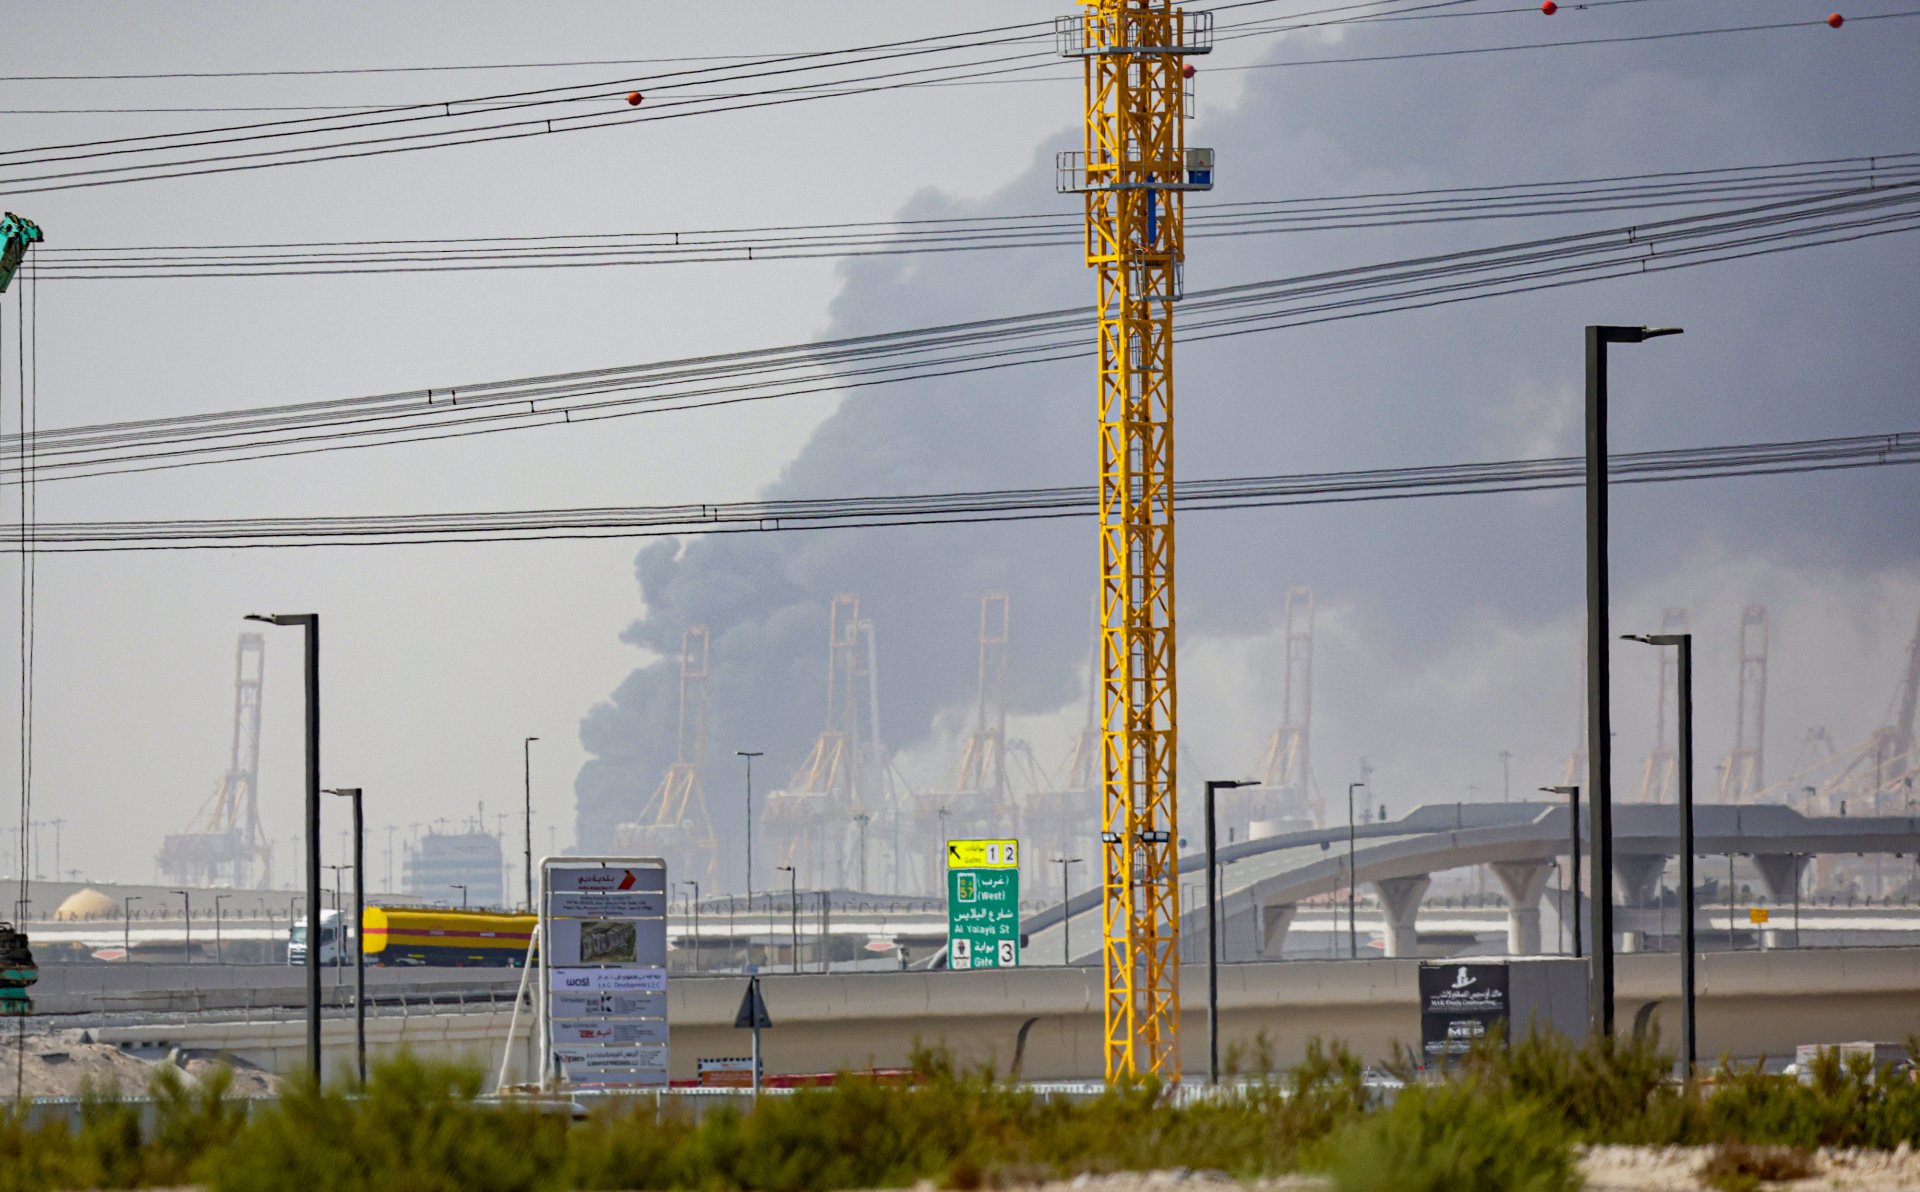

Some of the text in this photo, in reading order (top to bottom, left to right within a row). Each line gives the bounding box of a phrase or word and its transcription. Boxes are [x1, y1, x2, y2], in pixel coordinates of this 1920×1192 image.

[1005, 846, 1014, 861] 2
[960, 887, 974, 898] 57
[977, 890, 1006, 901] (West)
[988, 908, 1014, 922] شارع
[954, 924, 1010, 936] Al Yalayis St
[1001, 943, 1013, 962] 3
[975, 957, 993, 967] Gate
